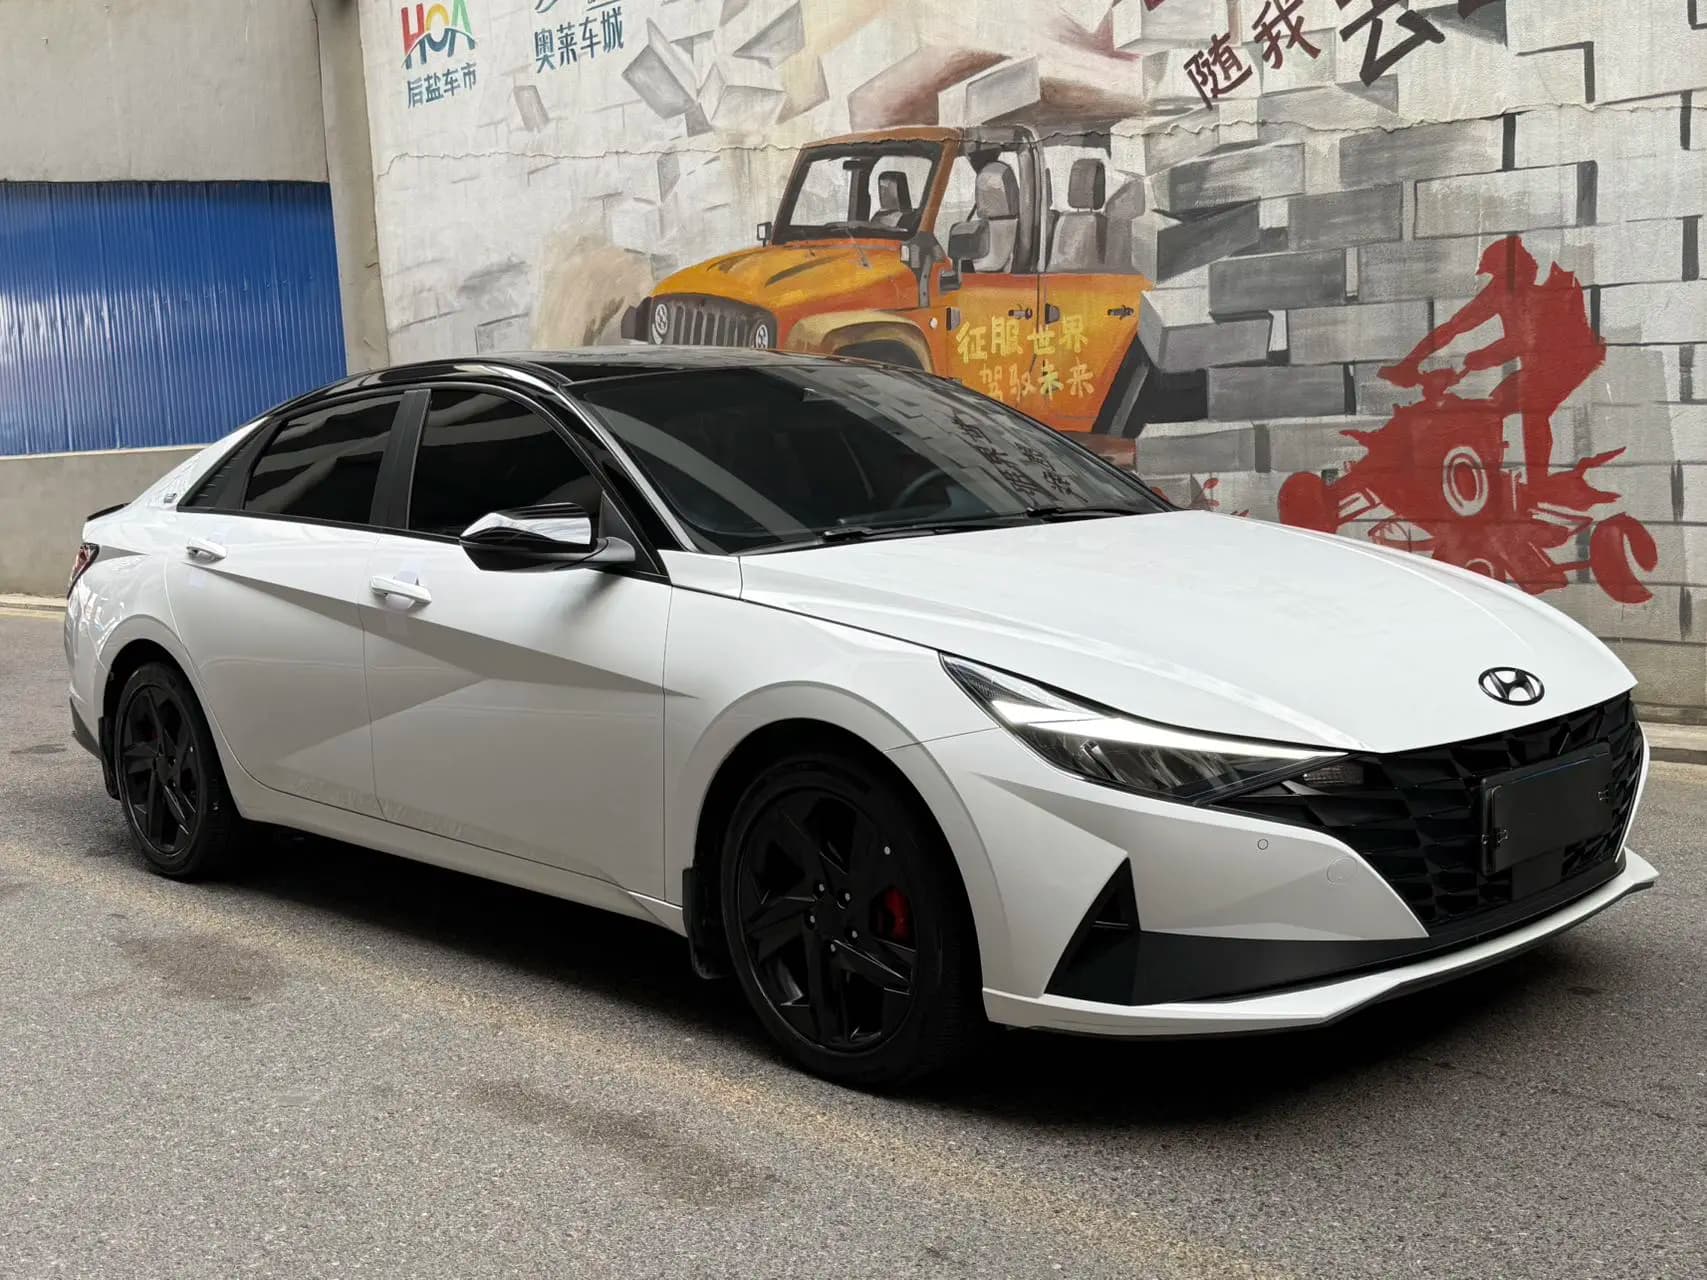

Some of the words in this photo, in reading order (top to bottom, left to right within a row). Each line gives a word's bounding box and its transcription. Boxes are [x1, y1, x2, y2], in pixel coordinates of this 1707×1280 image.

[534, 6, 624, 74] 奥莱车城
[407, 62, 477, 109] 后盐车市
[956, 314, 1088, 364] 征服世界
[979, 355, 1094, 402] 驾驭未来
